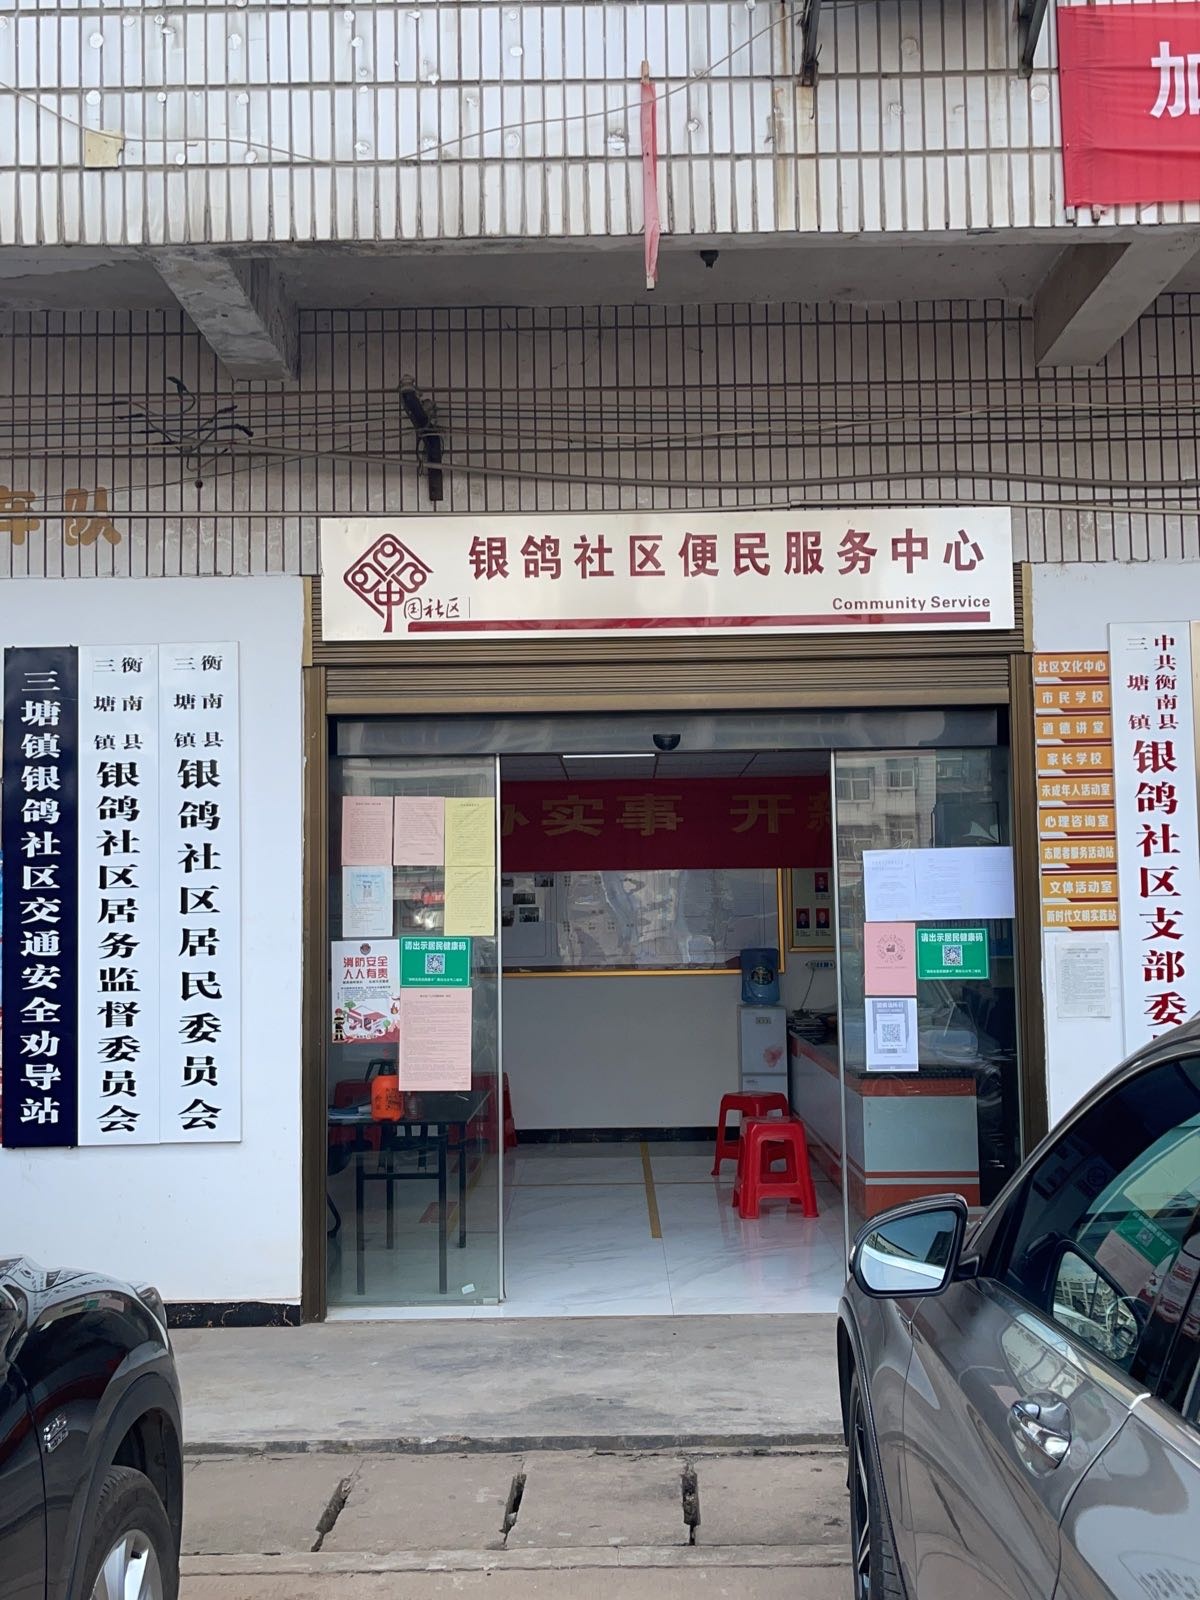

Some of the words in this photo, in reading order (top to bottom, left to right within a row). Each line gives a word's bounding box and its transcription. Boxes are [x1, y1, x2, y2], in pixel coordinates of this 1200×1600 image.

[468, 528, 984, 580] 银鸽社区便民服务中心
[832, 596, 926, 611] Community
[930, 595, 991, 609] Service
[1038, 660, 1106, 673] 社区文化中心
[1126, 636, 1151, 731] 三塘镇
[1154, 634, 1179, 730] 中共衡南县
[93, 658, 116, 751] 三塘镇
[121, 656, 143, 750] 衡南县
[173, 657, 197, 749] 三塘镇
[201, 655, 224, 748] 衡南县
[1042, 690, 1104, 704] 市民学校
[1042, 721, 1104, 735] 道德讲堂
[1047, 752, 1102, 765] 家长学校
[1041, 783, 1111, 797] 未成年人活动室
[1045, 815, 1109, 828] 心理咨询室
[1044, 845, 1114, 859] 志愿者服务活动站
[1049, 880, 1113, 894] 文体活动室
[1133, 739, 1188, 1040] 银鸽社区支部委
[20, 670, 61, 1124] 三塘镇银鸽社区交通安全劝导站
[1046, 908, 1117, 923] 新时代文明实践站
[177, 758, 223, 1130] 银鸽社区居民委员会
[921, 932, 984, 943] 请出示居民健康码
[96, 761, 141, 1133] 银鸽社区居务监督委员会
[405, 941, 467, 951] 请出示居民健康码
[343, 955, 388, 968] 消防安全
[343, 968, 388, 980] 人人有责
